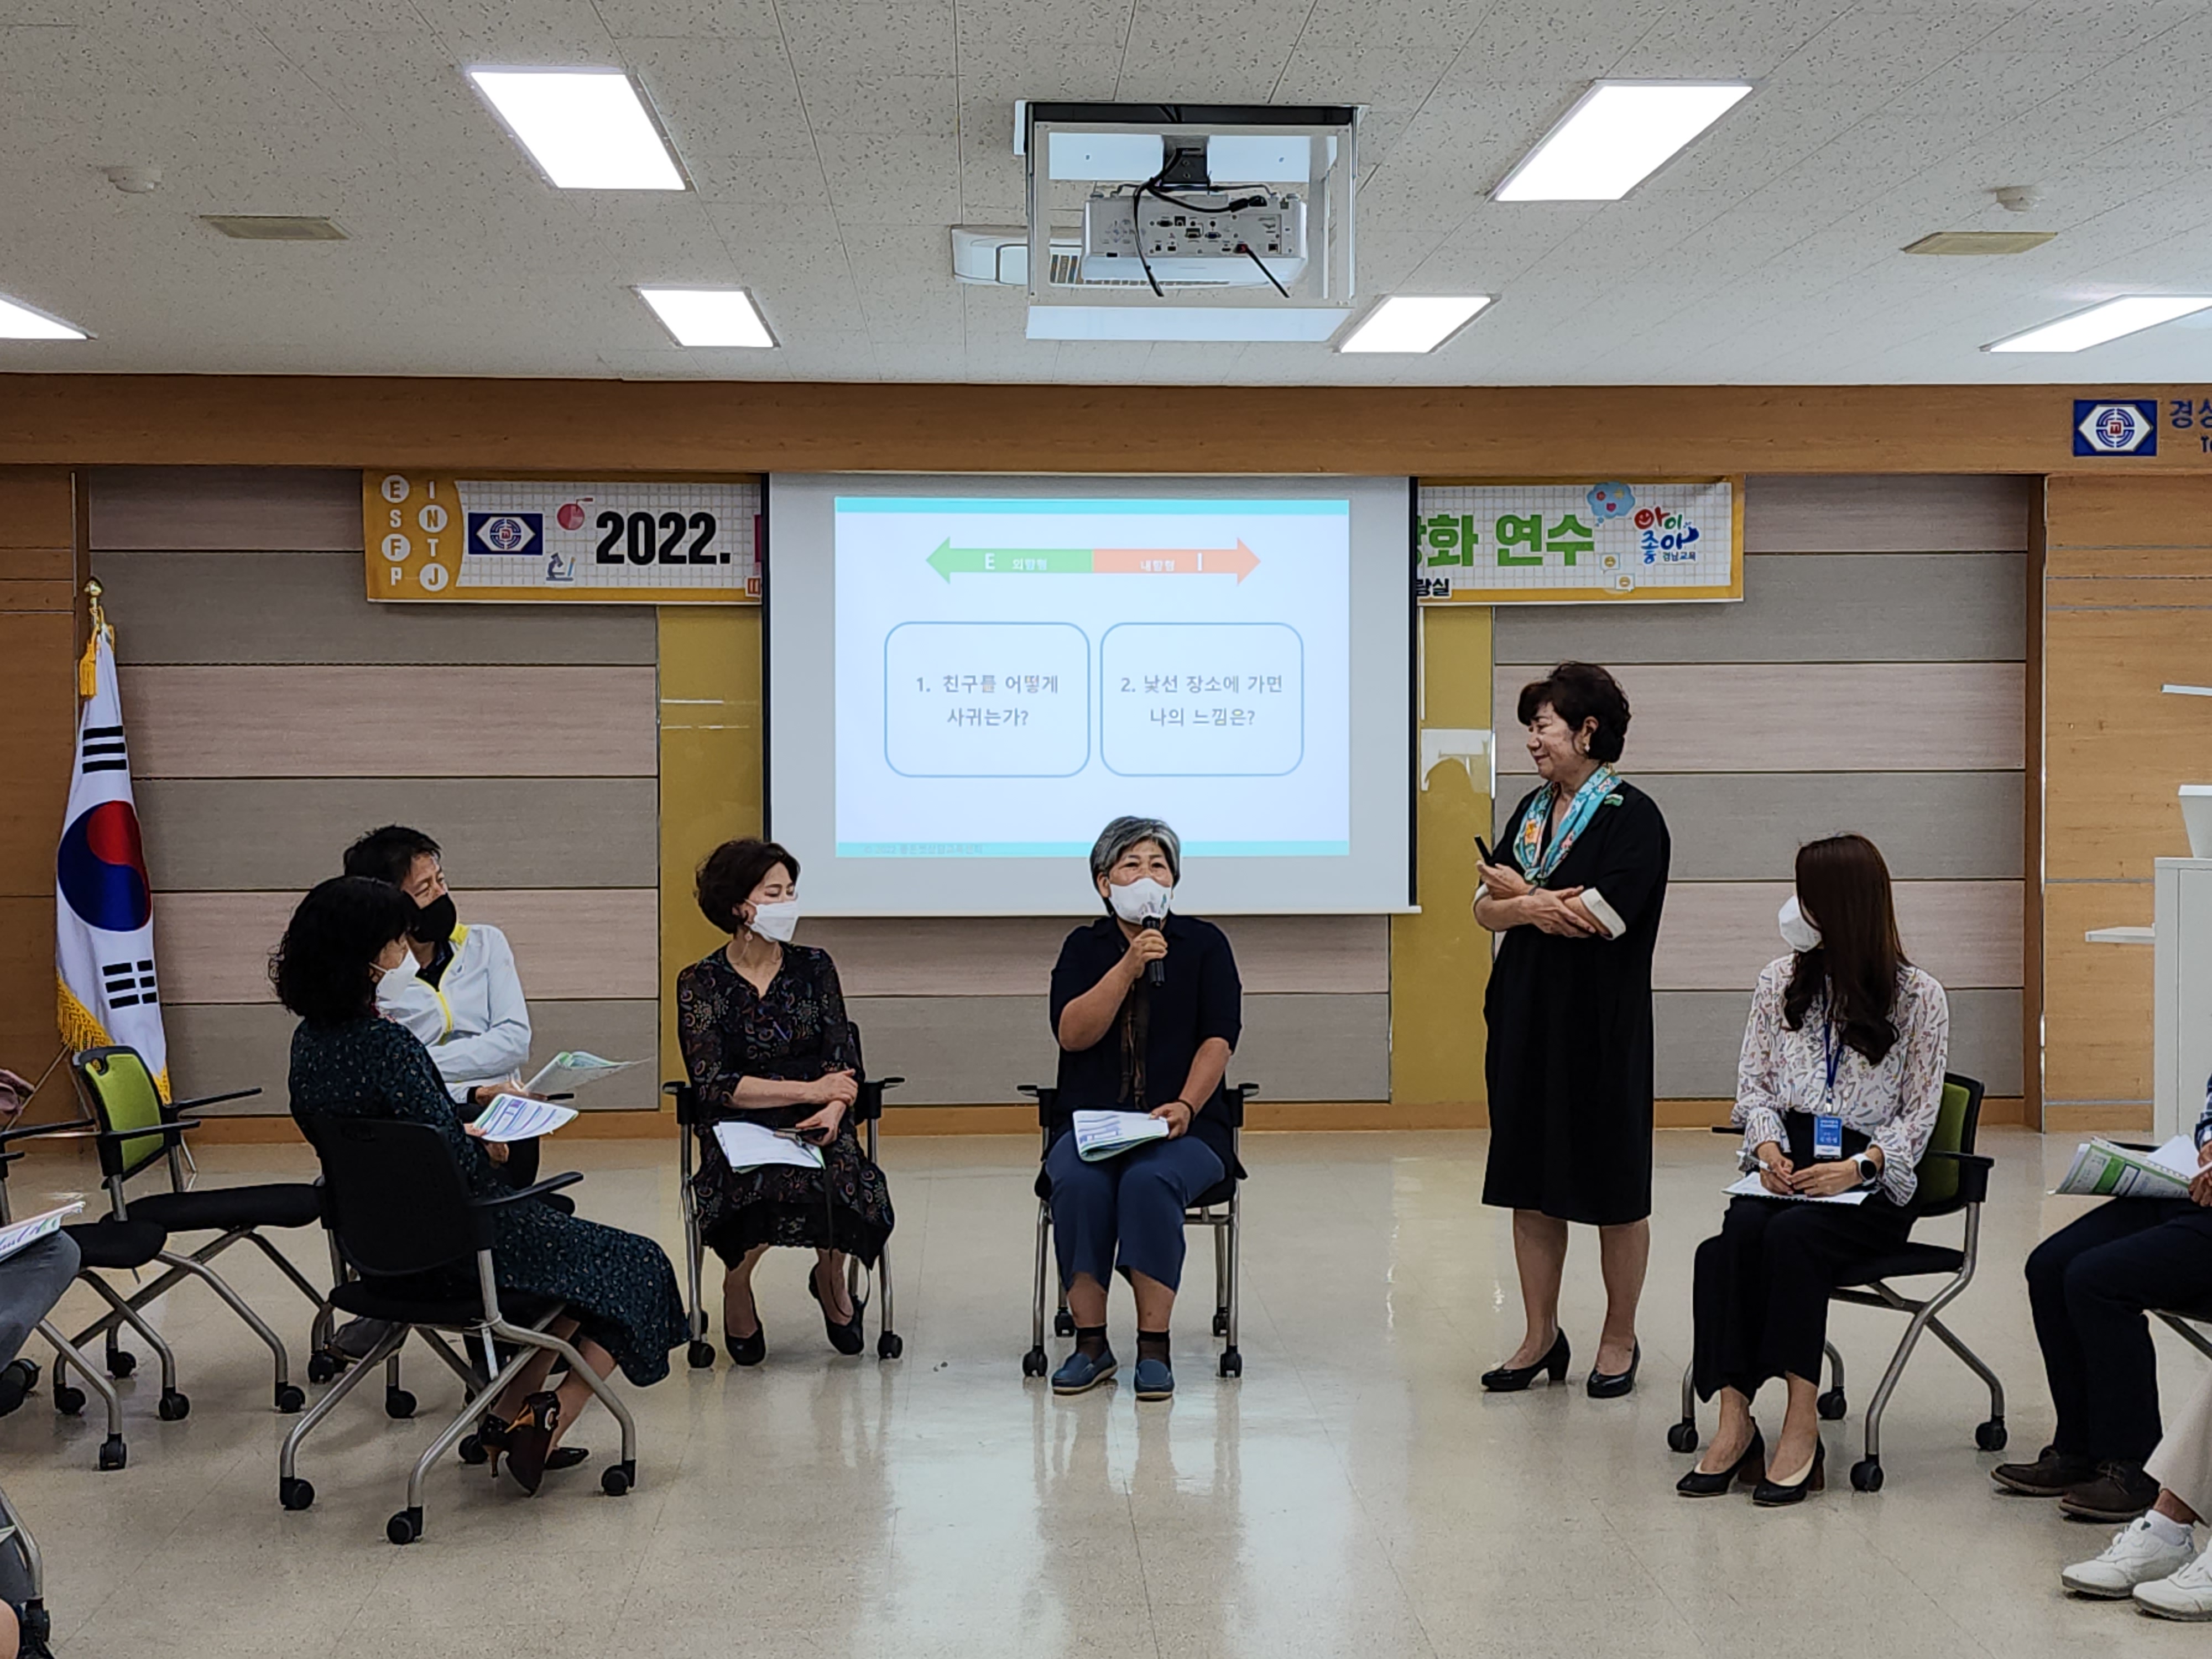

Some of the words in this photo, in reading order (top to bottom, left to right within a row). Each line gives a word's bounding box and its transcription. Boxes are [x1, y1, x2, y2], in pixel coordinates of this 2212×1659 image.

[1634, 506, 1682, 530] 아이
[596, 510, 731, 565] 2022.
[1496, 514, 1594, 566] 연수
[1641, 526, 1699, 564] 좋아
[985, 552, 995, 570] E
[1197, 552, 1202, 571] I
[1663, 551, 1696, 562] 경남교육
[916, 677, 931, 692] 1.
[943, 674, 997, 693] 친구를
[1005, 675, 1058, 693] 어떻게
[1120, 677, 1136, 692] 2.
[1144, 675, 1178, 693] 낯선
[1186, 675, 1239, 693] 장소에
[1248, 675, 1282, 693] 가면
[947, 707, 1029, 727] 사귀는가?
[1150, 708, 1184, 727] 나의
[1192, 708, 1255, 726] 느낌은?
